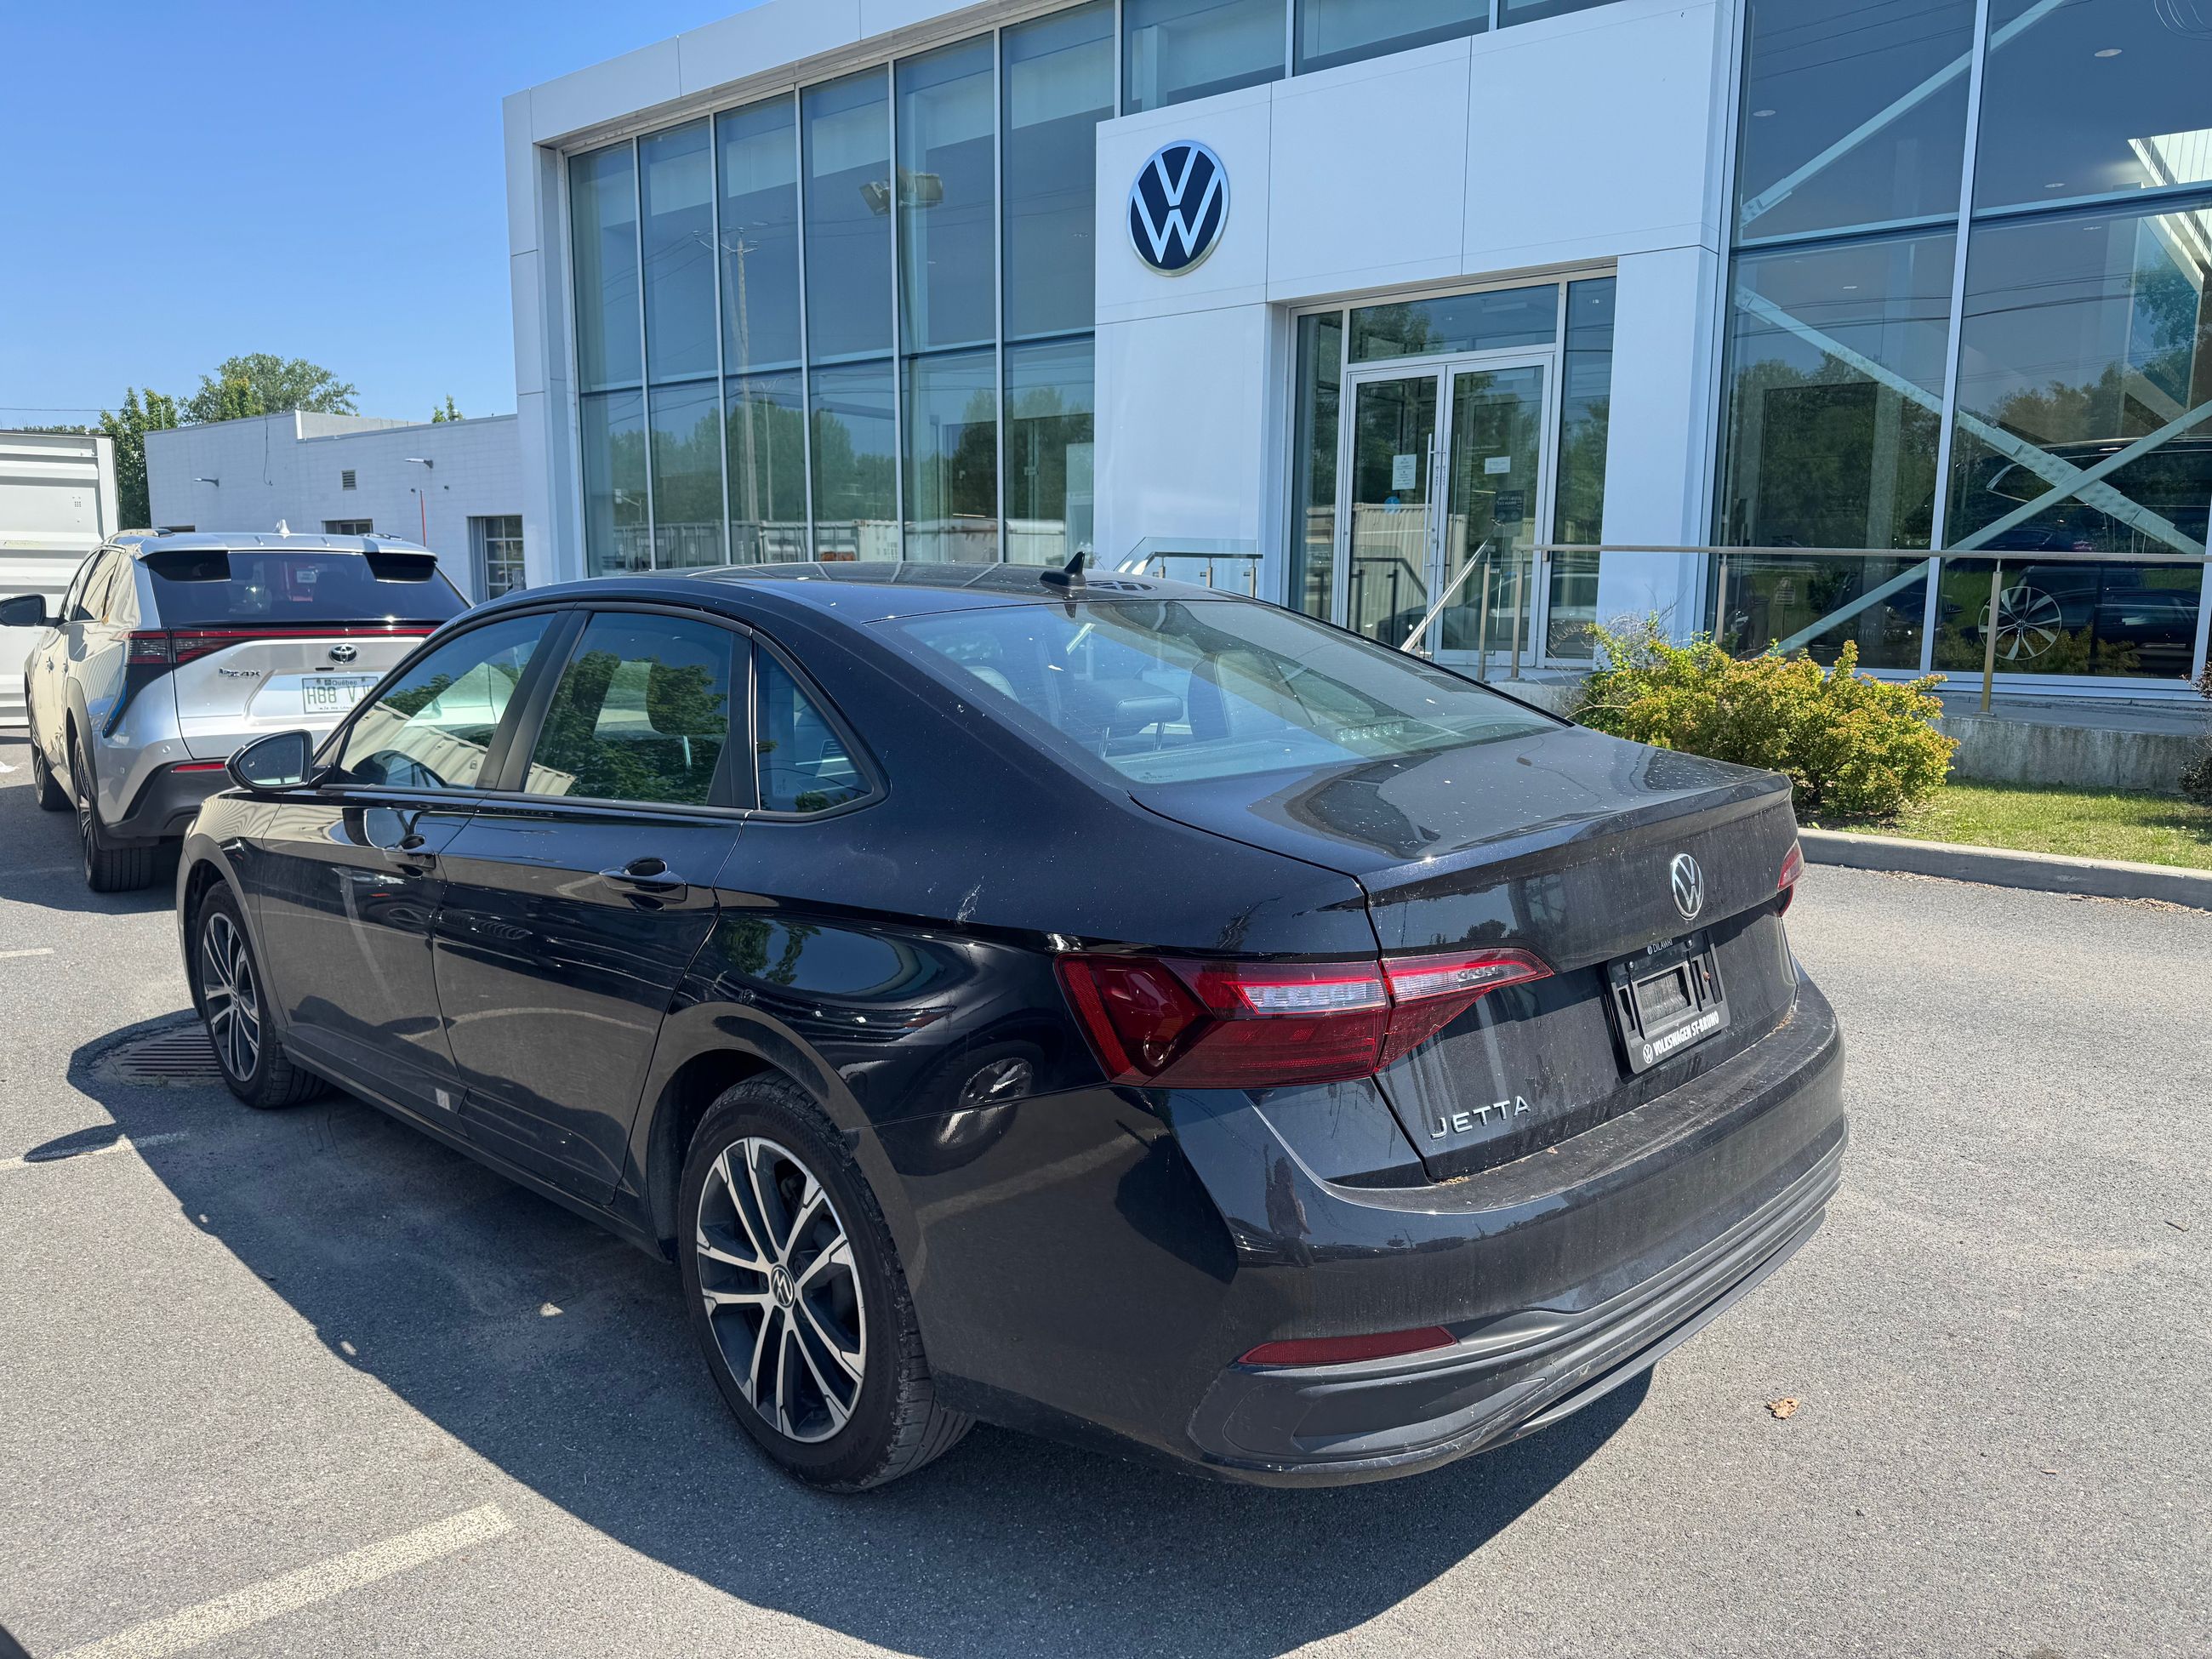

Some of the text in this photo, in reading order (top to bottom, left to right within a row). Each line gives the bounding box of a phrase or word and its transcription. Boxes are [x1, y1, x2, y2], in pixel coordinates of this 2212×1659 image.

[1128, 141, 1228, 272] VW
[306, 687, 337, 704] H88
[1672, 853, 1703, 917] VW
[1653, 1025, 1692, 1056] VOLKSWAGEN
[1691, 1011, 1719, 1036] ST-BRUNO
[1430, 1095, 1531, 1139] JETTA
